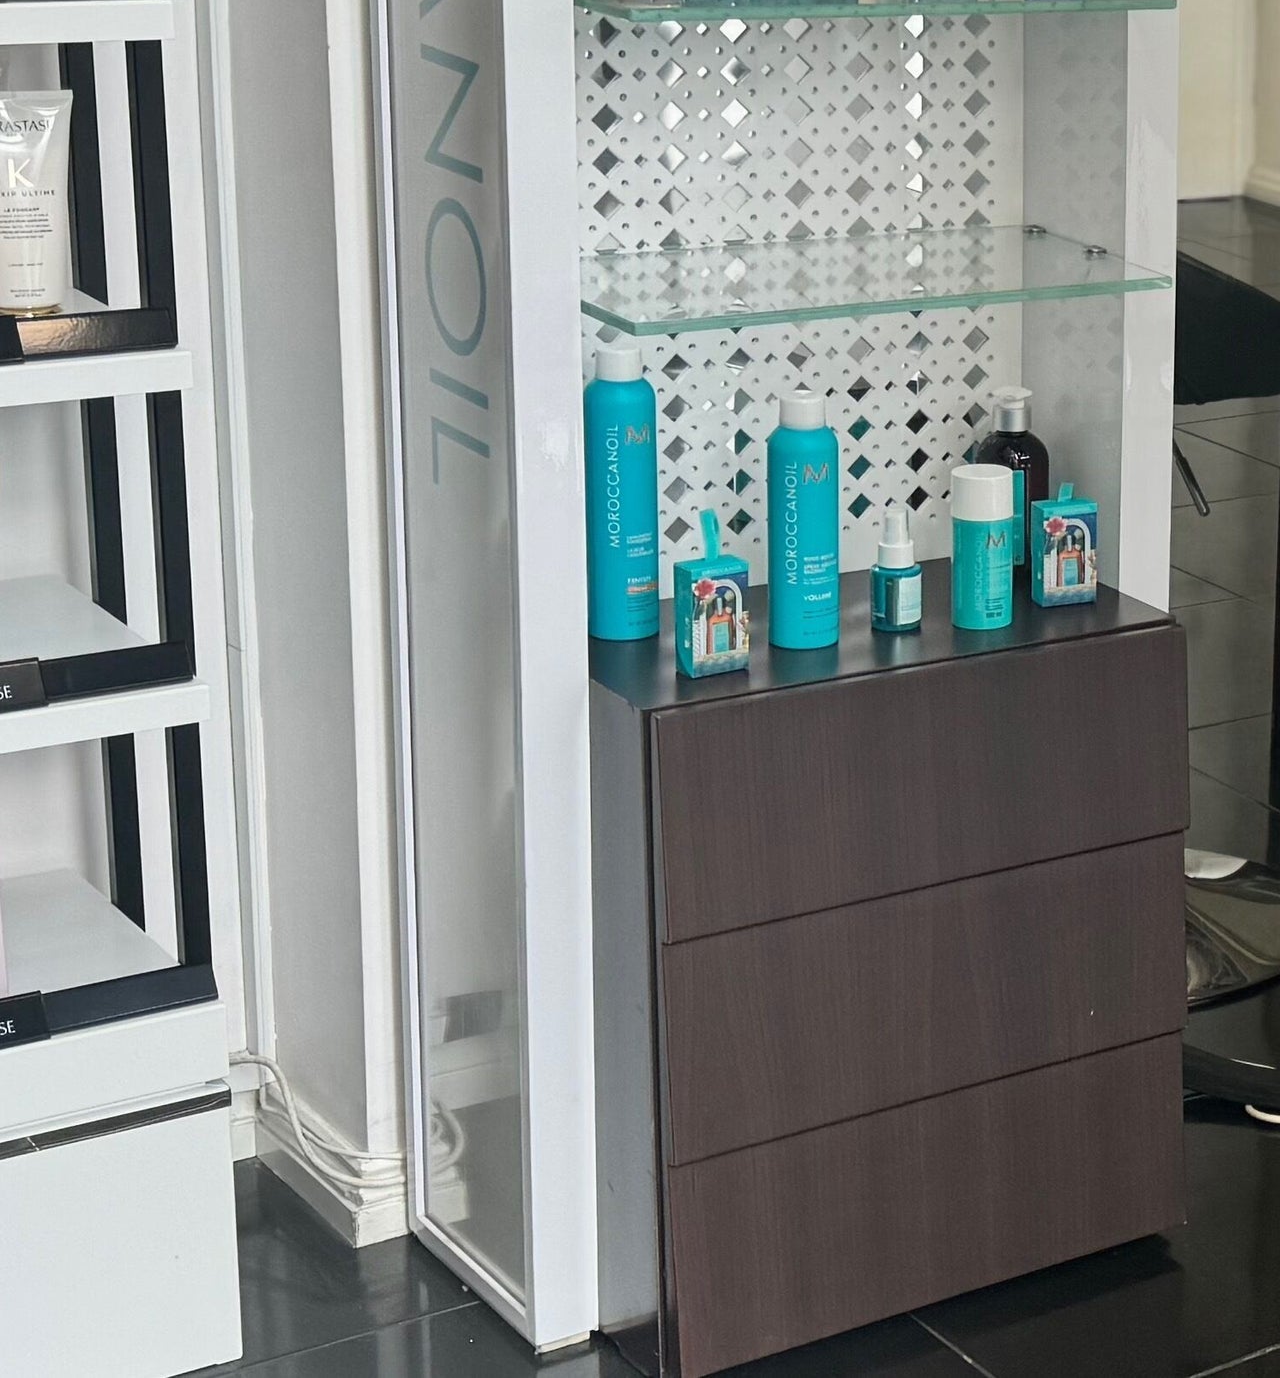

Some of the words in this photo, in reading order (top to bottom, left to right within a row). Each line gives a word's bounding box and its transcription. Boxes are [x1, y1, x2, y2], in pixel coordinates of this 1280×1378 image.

[7, 158, 34, 188] K
[606, 424, 621, 549] MOROCCANOIL
[784, 461, 799, 586] MOROCCANOIL
